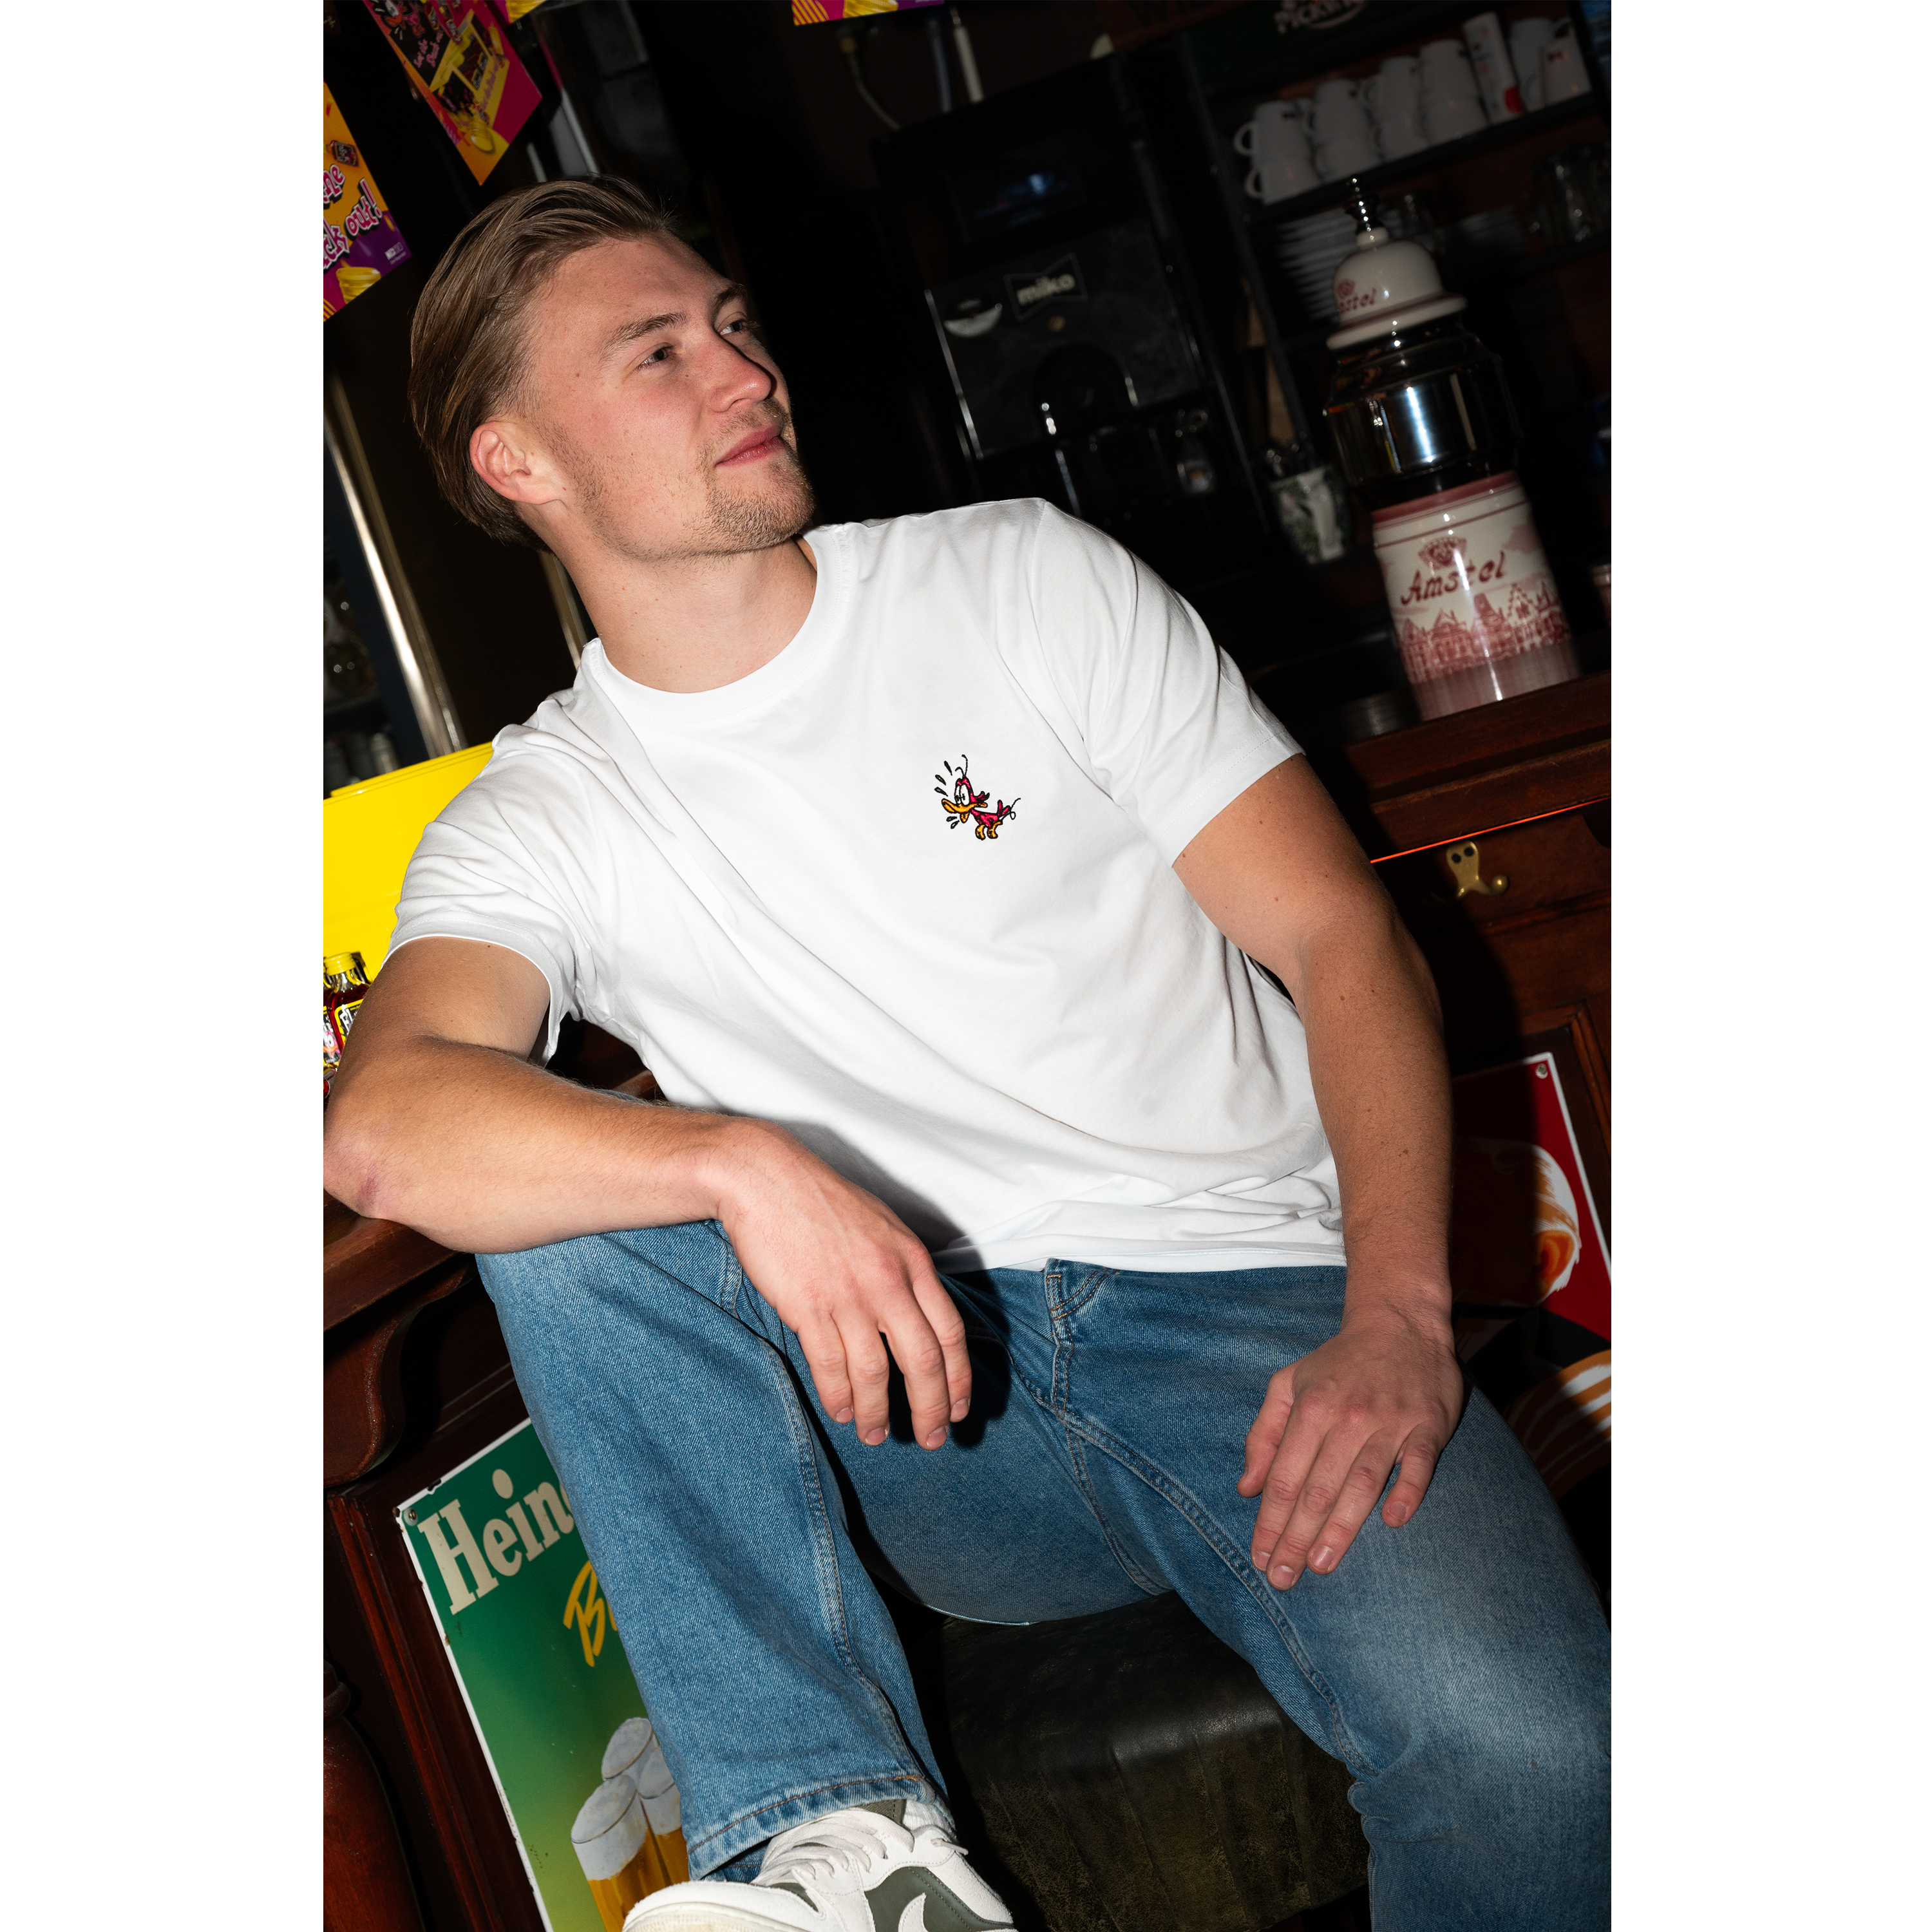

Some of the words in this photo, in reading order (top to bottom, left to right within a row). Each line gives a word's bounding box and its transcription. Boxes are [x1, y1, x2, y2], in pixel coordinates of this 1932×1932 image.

[344, 177, 383, 237] out!
[1016, 272, 1077, 307] miko
[1399, 549, 1506, 605] Amstel
[417, 1468, 574, 1616] Hein
[562, 1559, 623, 1668] B
